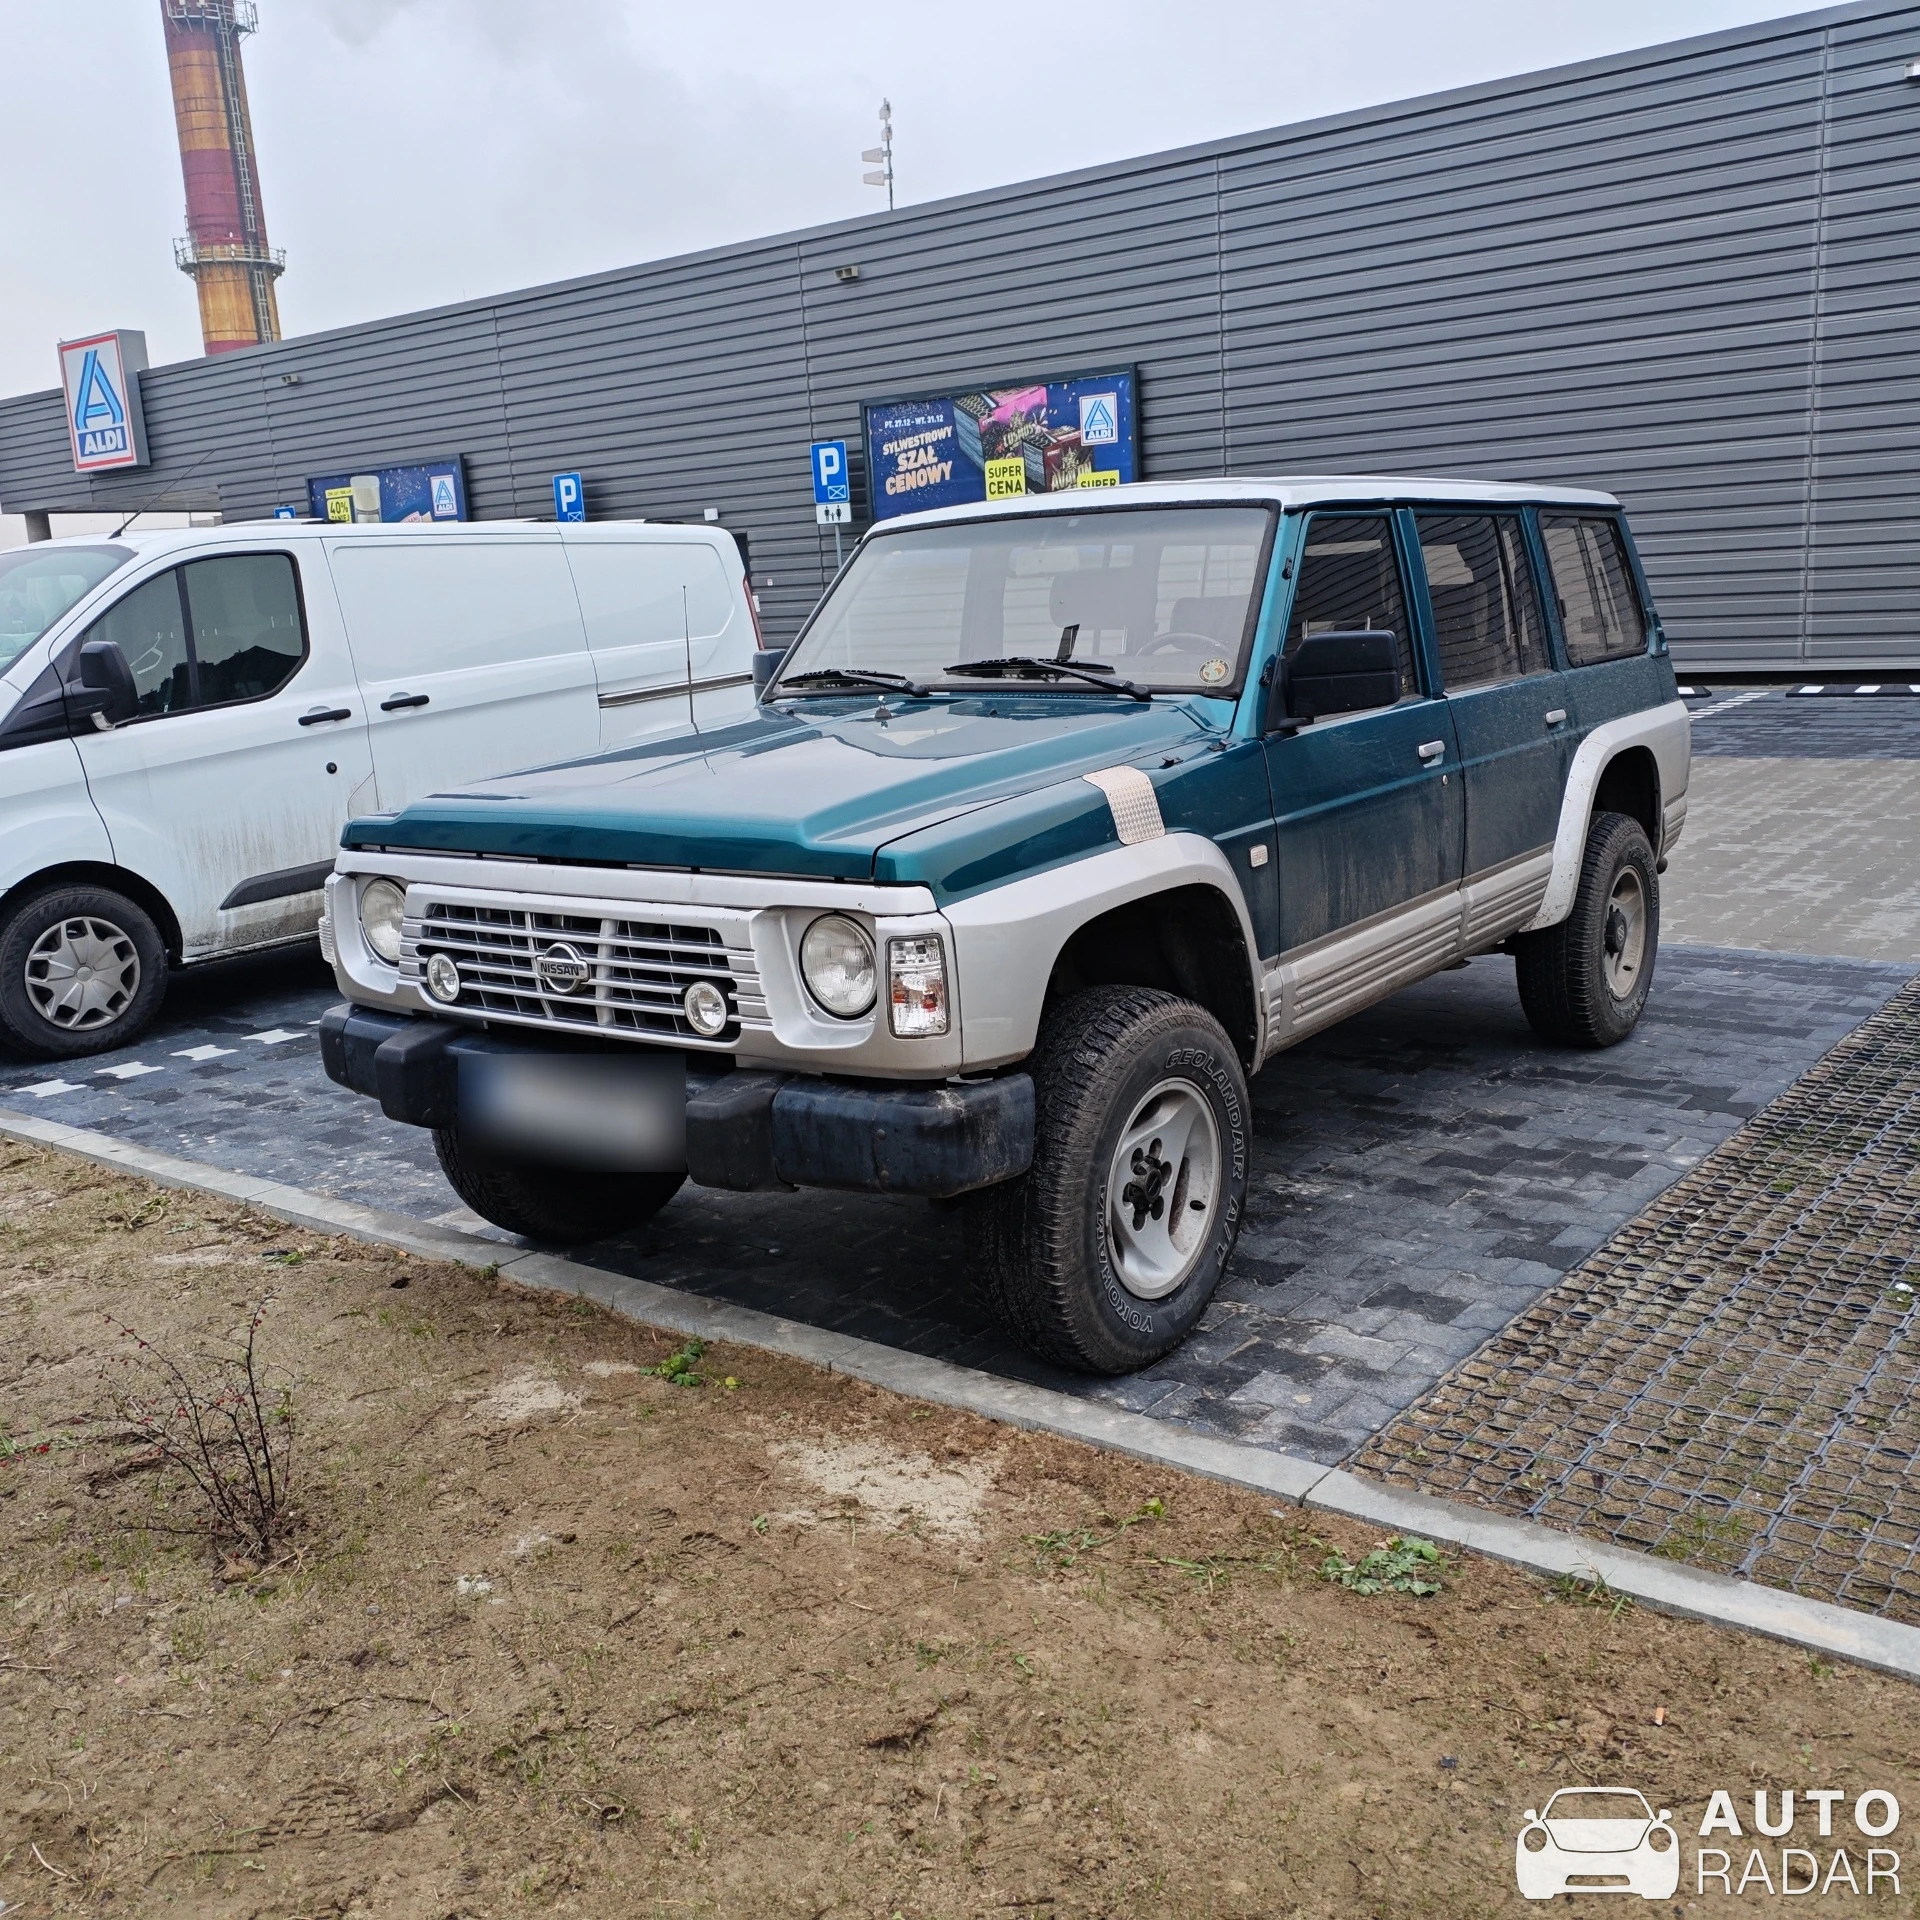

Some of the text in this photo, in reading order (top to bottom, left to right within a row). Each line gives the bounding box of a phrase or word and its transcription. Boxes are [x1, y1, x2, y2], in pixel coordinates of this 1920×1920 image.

[894, 418, 911, 428] 27.12
[927, 414, 944, 424] 31.12
[1087, 429, 1112, 440] ALDI
[84, 428, 124, 455] ALDI
[882, 425, 953, 456] SYLWESTROWY
[818, 447, 840, 486] P
[897, 445, 938, 472] SZAŁ
[988, 465, 1022, 479] SUPER
[885, 460, 953, 496] CENOWY
[988, 479, 1023, 495] CENA
[330, 500, 349, 514] 40%
[438, 503, 453, 511] ALDI
[559, 478, 577, 513] P
[541, 962, 578, 976] NISSAN
[1165, 1047, 1246, 1268] GEOLANDAR A/T
[1096, 1184, 1154, 1334] YOKOHAMA
